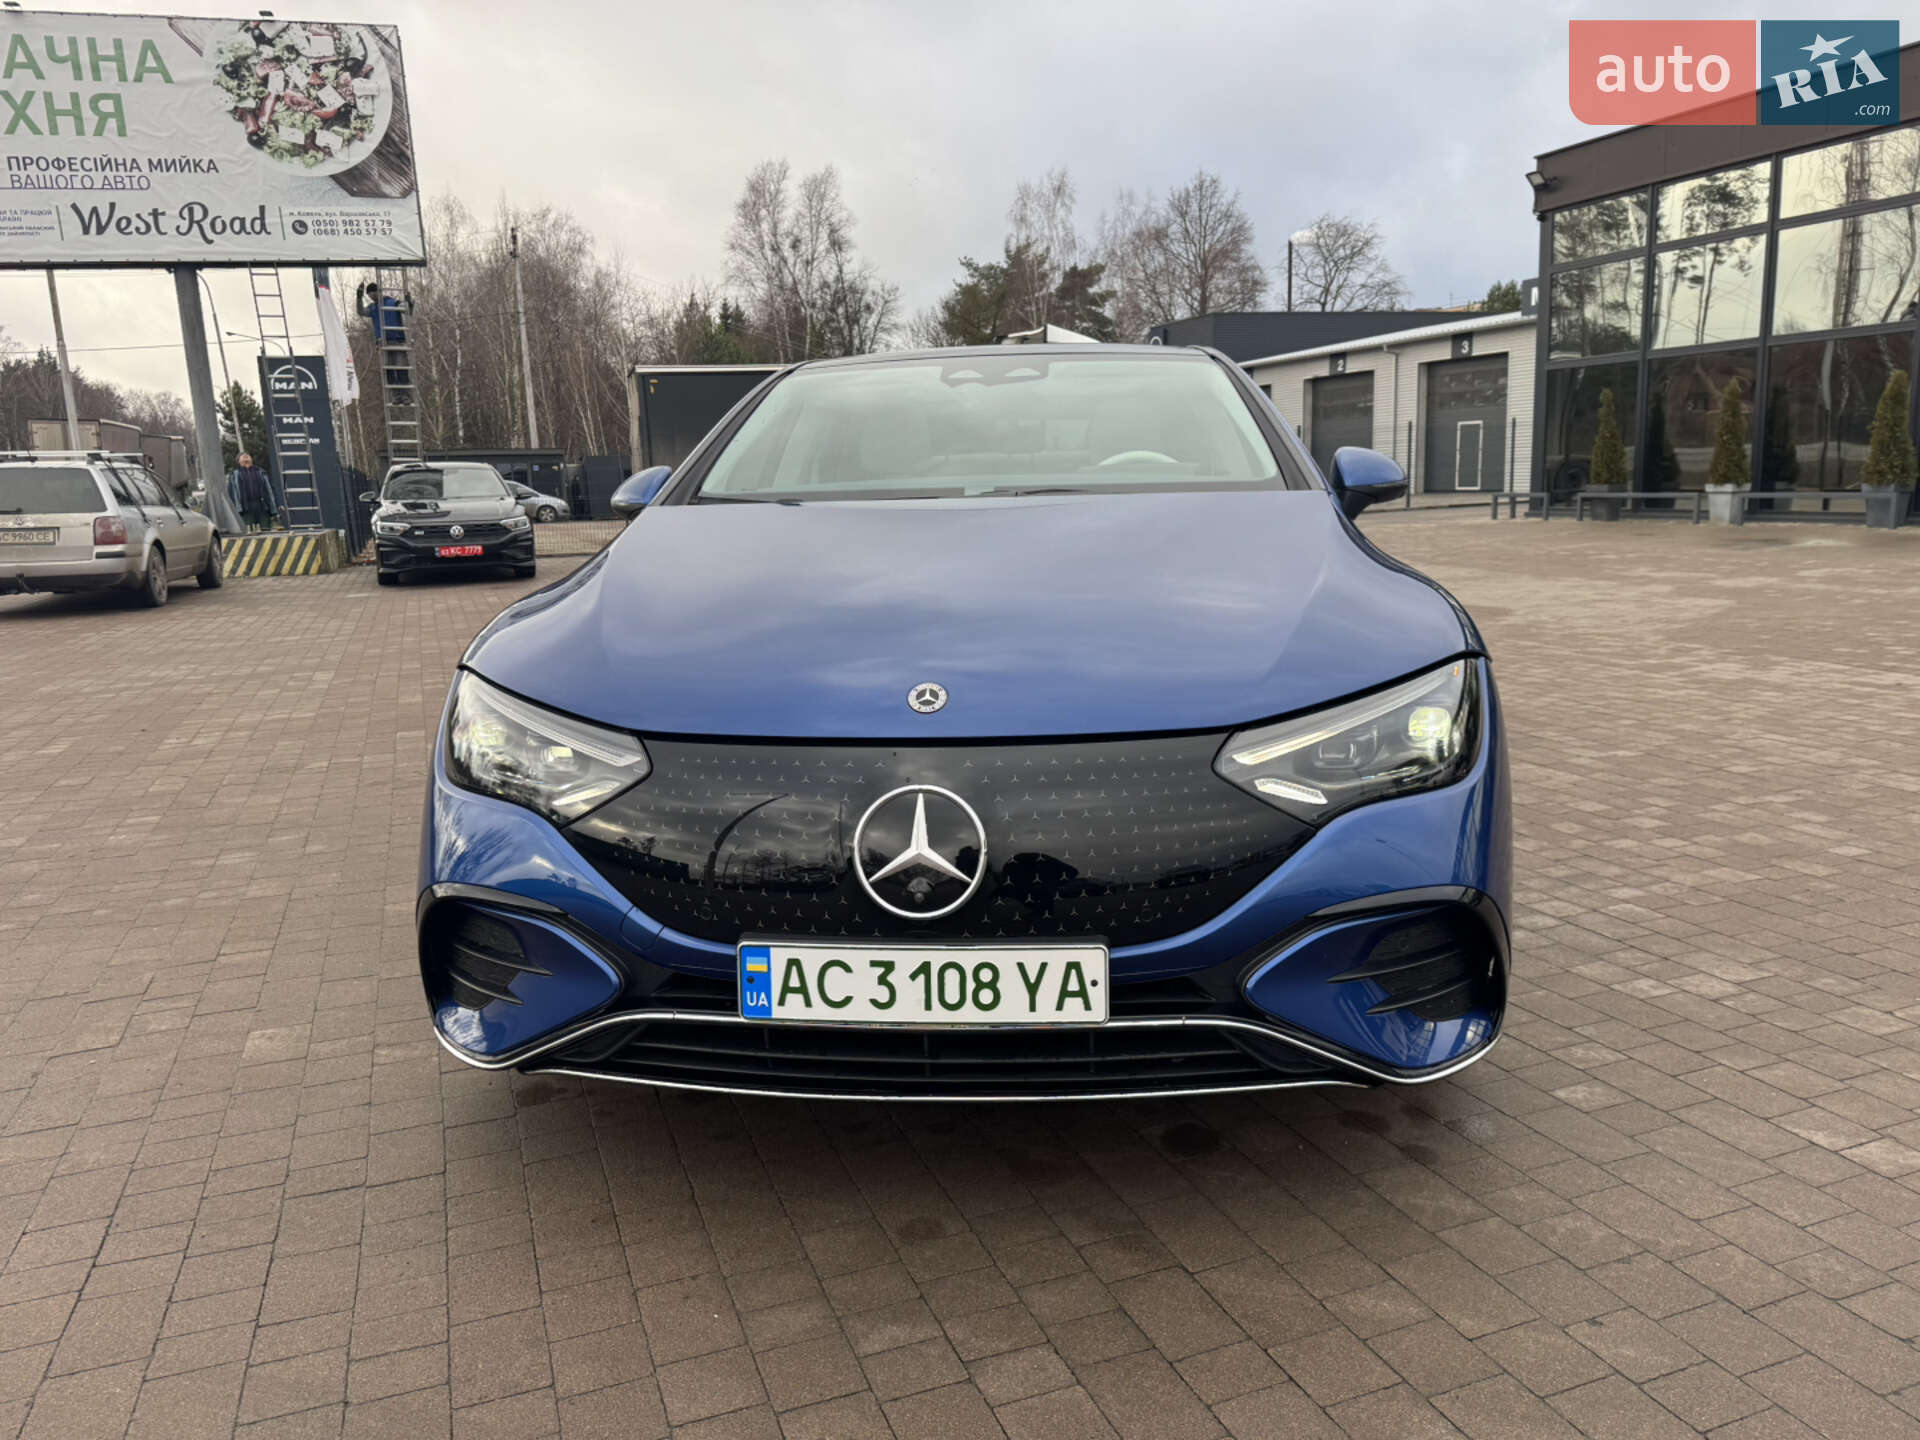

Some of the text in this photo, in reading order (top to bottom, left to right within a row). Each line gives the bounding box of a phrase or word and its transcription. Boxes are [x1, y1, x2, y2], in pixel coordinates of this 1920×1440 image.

[3, 33, 175, 84] АЧНА
[0, 90, 128, 137] ХНЯ
[6, 154, 220, 174] ПРОФЕСІЙНА МИЙКА
[10, 174, 151, 190] ВАШОГО АВТО
[70, 201, 272, 245] West Road
[311, 219, 339, 228] (050)
[342, 219, 361, 228] 982
[313, 227, 393, 236] (068) 450 57 57
[1461, 340, 1470, 354] 3
[1336, 359, 1345, 372] 2
[274, 381, 314, 391] MAN
[282, 416, 315, 424] MAN
[777, 957, 1093, 1013] AC 3108 YA
[746, 991, 769, 1008] UA
